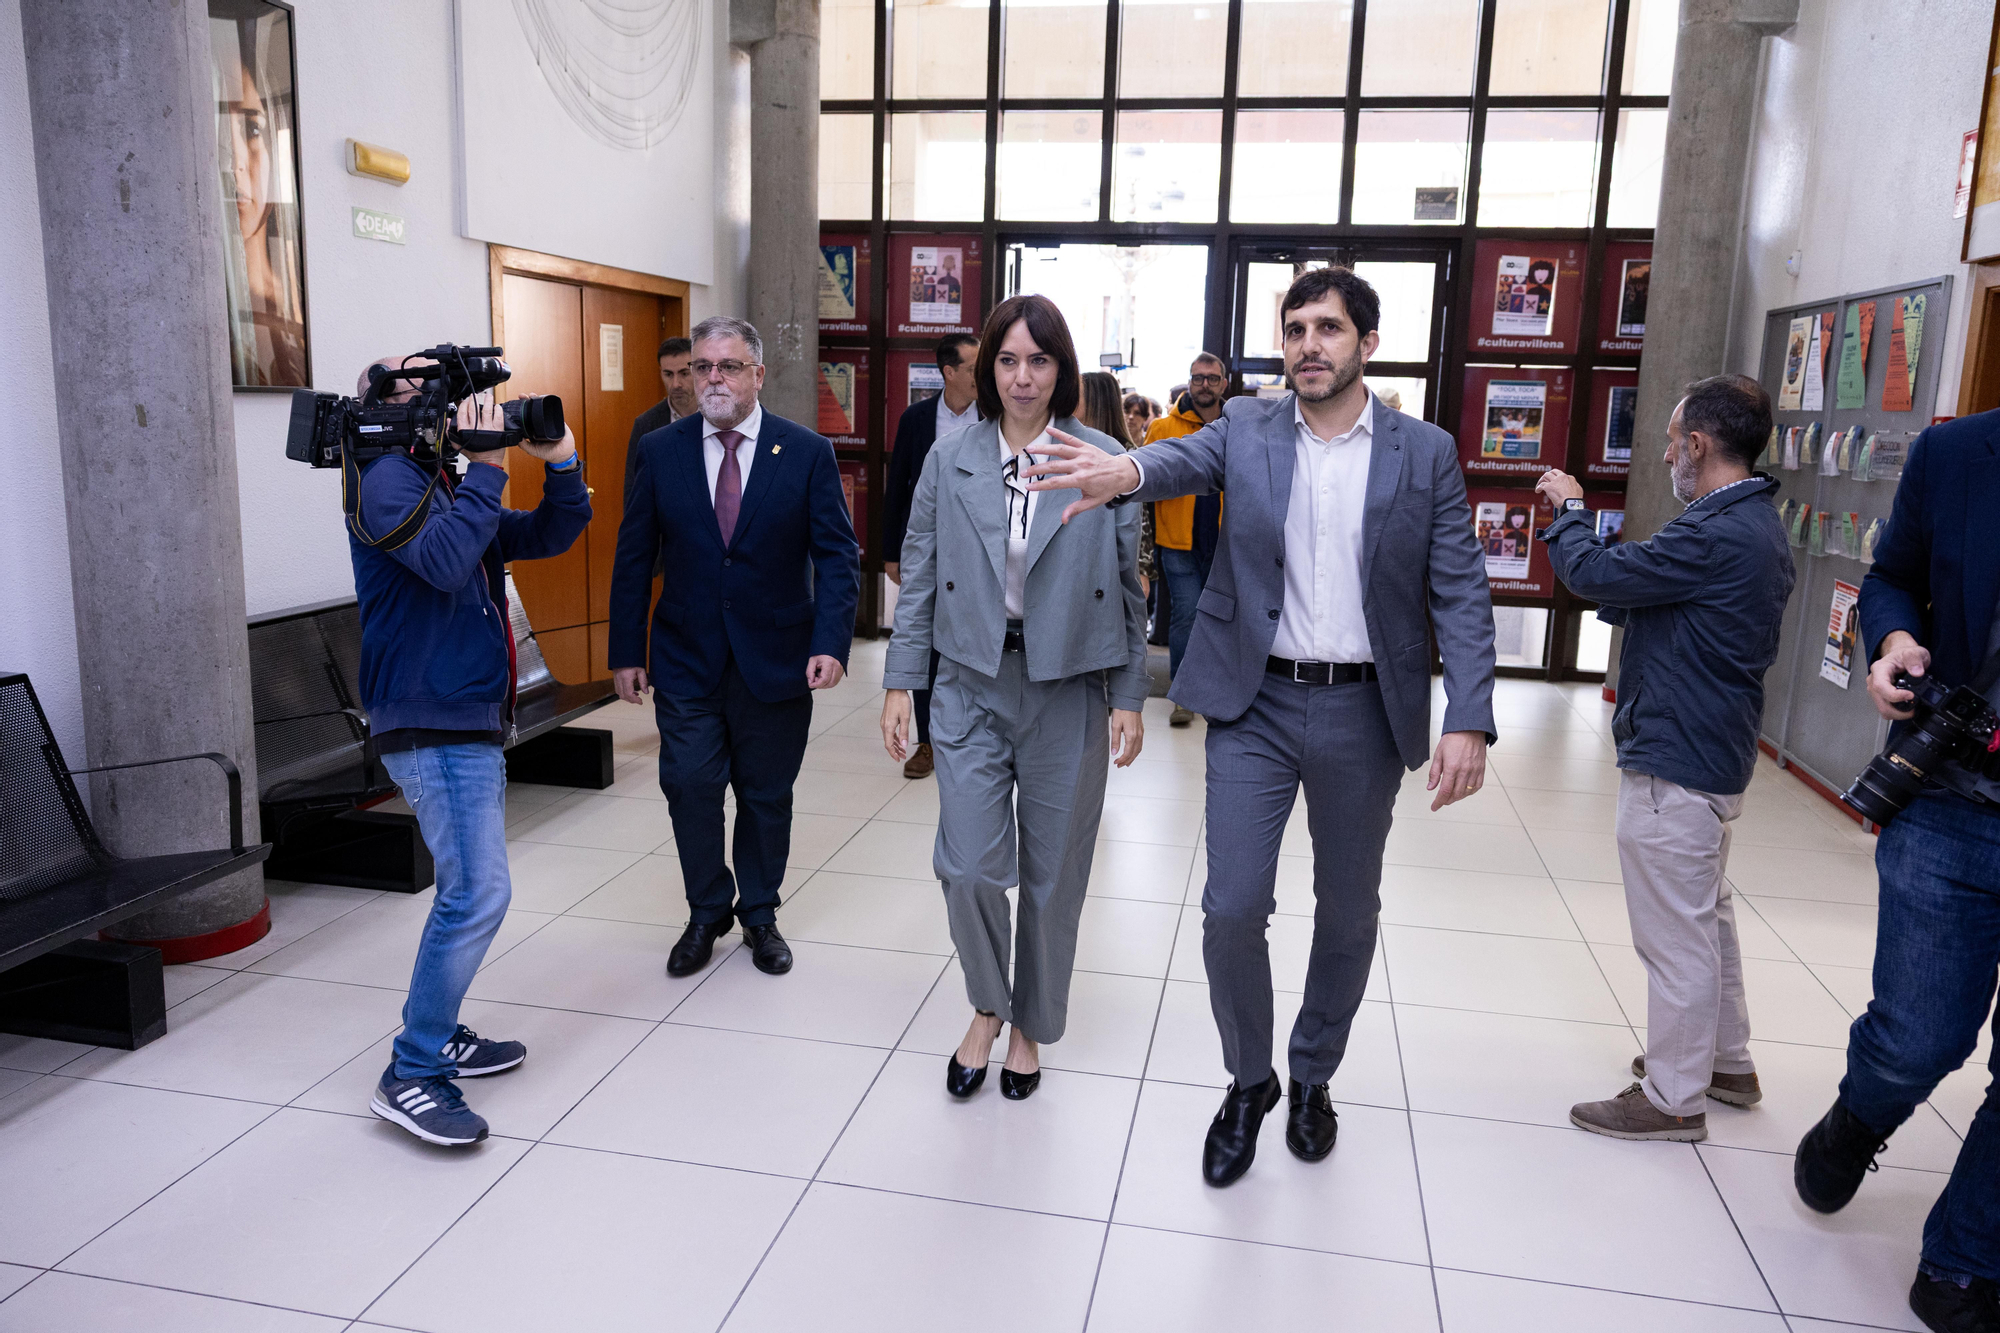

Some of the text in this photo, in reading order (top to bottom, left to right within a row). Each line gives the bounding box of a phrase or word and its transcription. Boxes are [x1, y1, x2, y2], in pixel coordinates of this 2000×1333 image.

[366, 215, 390, 235] DEA
[819, 322, 868, 331] uravillena
[898, 324, 973, 334] #culturavillena
[1477, 337, 1564, 349] #culturavillena
[1600, 340, 1643, 350] #cultur
[830, 436, 867, 445] avillena
[1467, 460, 1552, 472] #culturavillena
[1588, 463, 1629, 474] #cultur
[1489, 581, 1541, 591] ravillena
